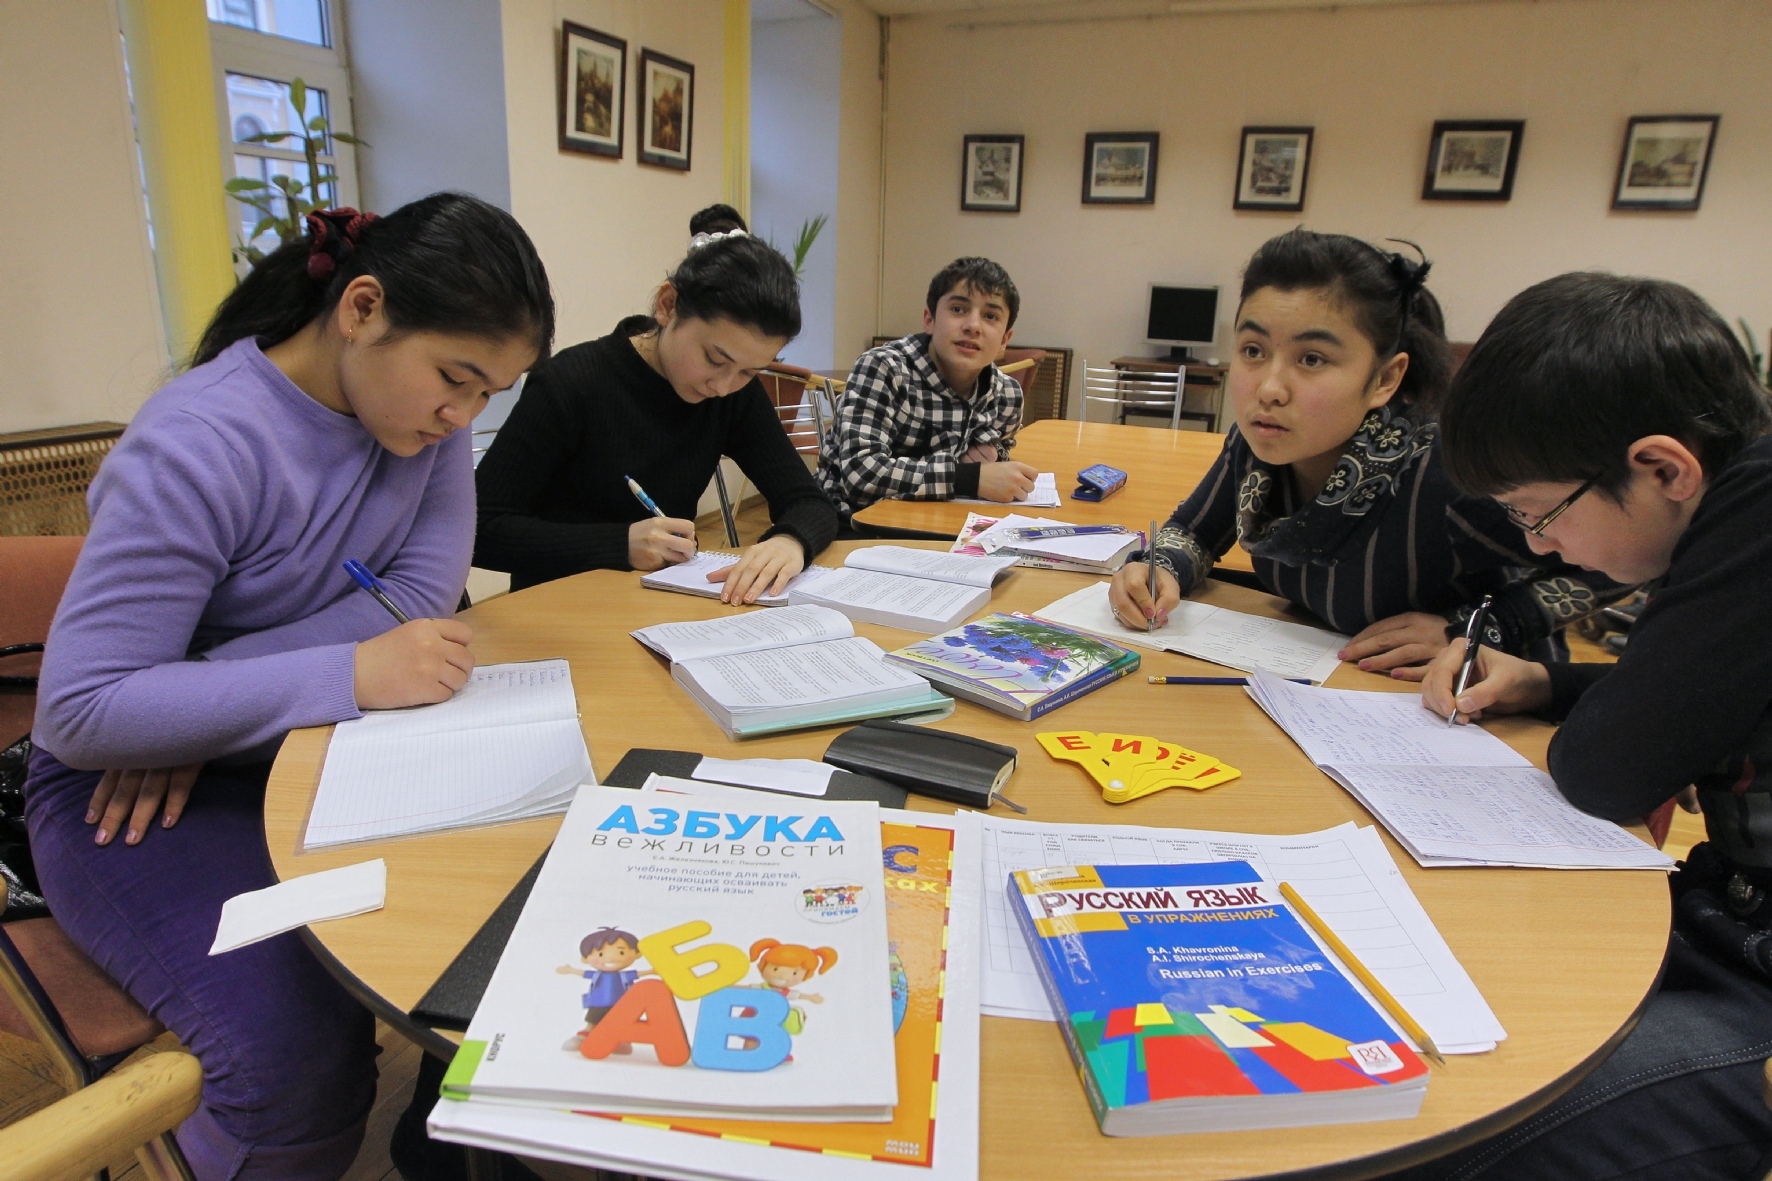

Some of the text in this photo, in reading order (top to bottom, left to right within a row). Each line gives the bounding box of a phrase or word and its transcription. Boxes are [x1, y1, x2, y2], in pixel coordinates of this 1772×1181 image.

[1056, 736, 1092, 750] Е
[1112, 738, 1142, 754] И
[596, 804, 845, 842] АЗБУКА
[627, 864, 801, 880] учебное пособие для детей,
[638, 874, 788, 887] начинающих осваивать
[668, 884, 754, 895] русский язык
[1186, 886, 1269, 908] ЯЗЫК
[1128, 908, 1279, 924] В УПРАЖНЕНИЯХ
[1146, 945, 1239, 955] S.A. Khavronina
[1152, 952, 1266, 963] A.I. Shirochenskaya
[637, 919, 750, 1001] Б
[1159, 963, 1323, 979] Russian in Exercises
[580, 978, 792, 1073] А В
